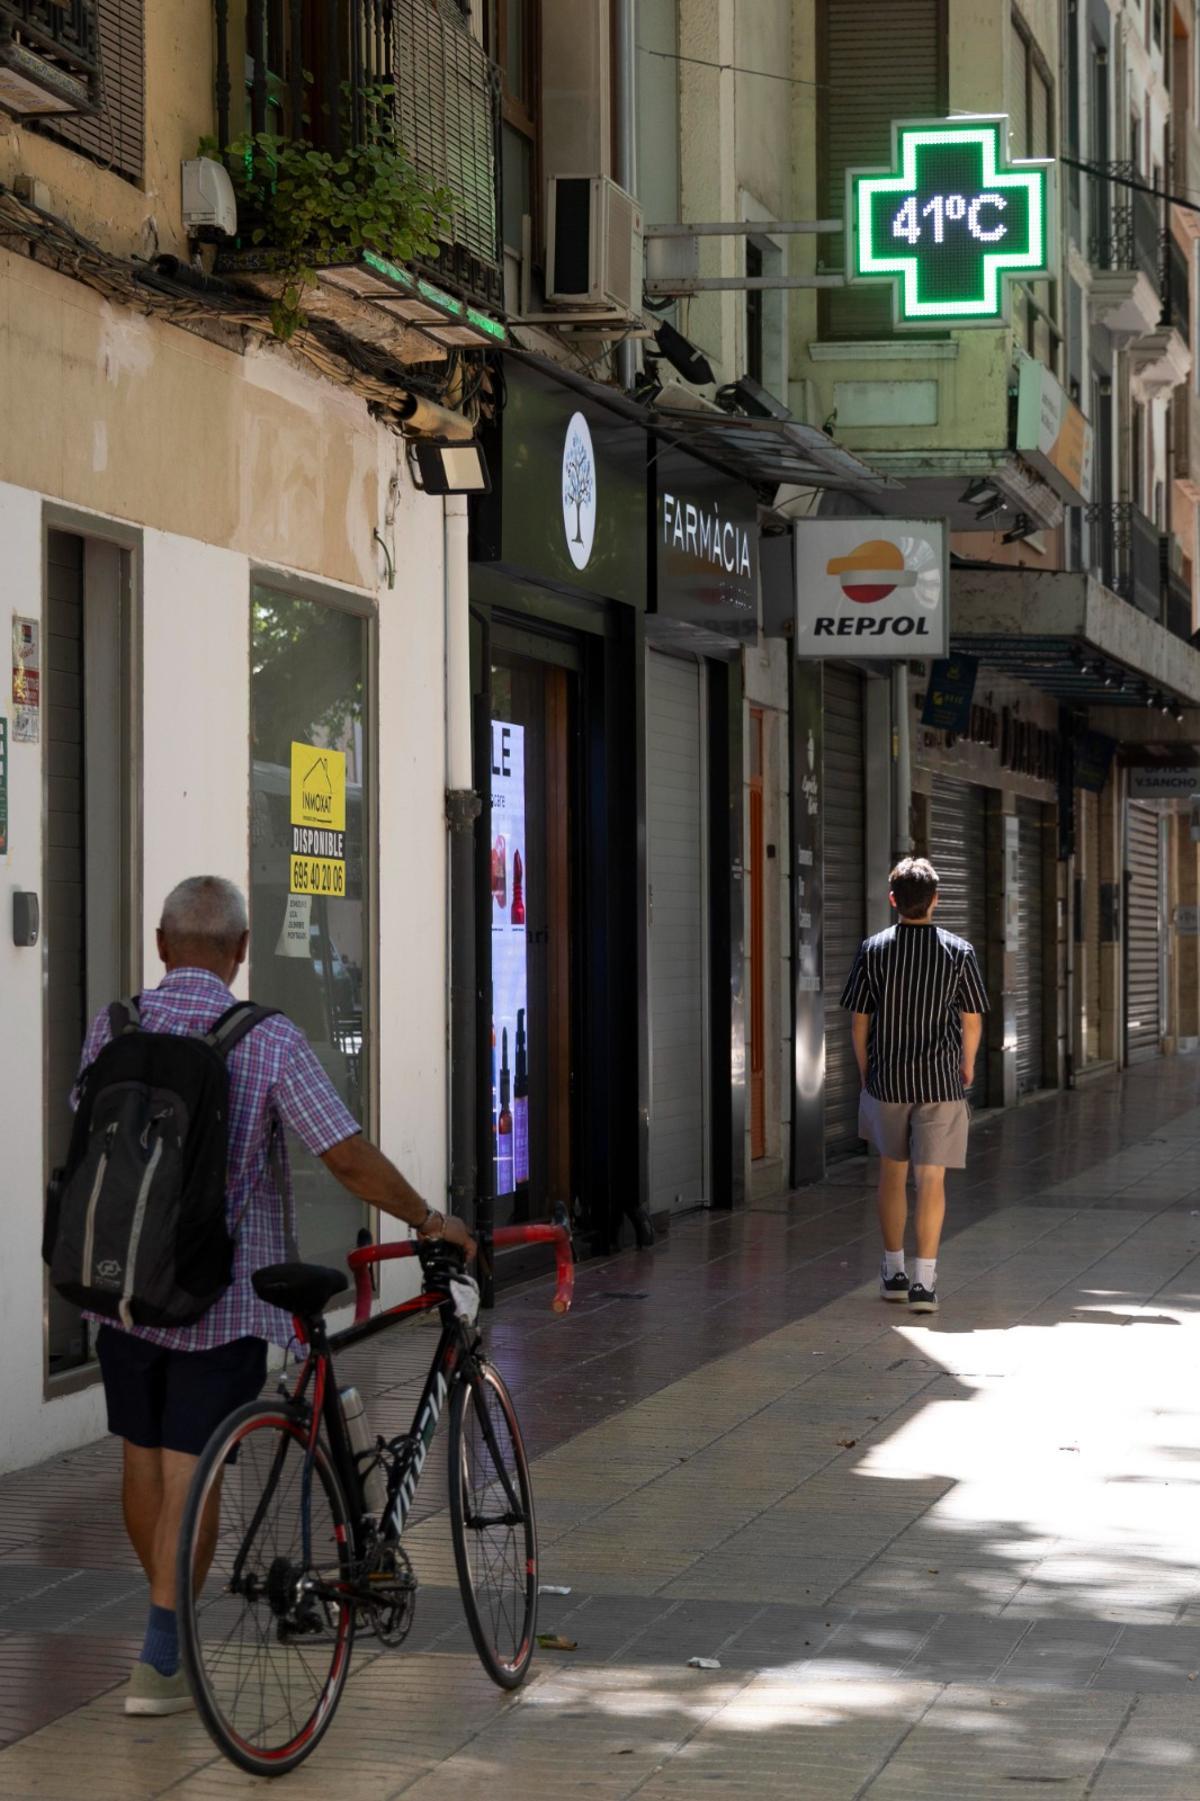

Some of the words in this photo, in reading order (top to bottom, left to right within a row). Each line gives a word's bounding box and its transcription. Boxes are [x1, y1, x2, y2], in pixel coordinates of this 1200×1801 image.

[664, 493, 751, 579] FARMÀCIA
[814, 616, 929, 636] REPSOL
[293, 827, 343, 858] DISPONIBLE
[294, 861, 308, 889] 695
[310, 862, 320, 891] 40
[322, 864, 332, 892] 20
[333, 865, 343, 892] 06
